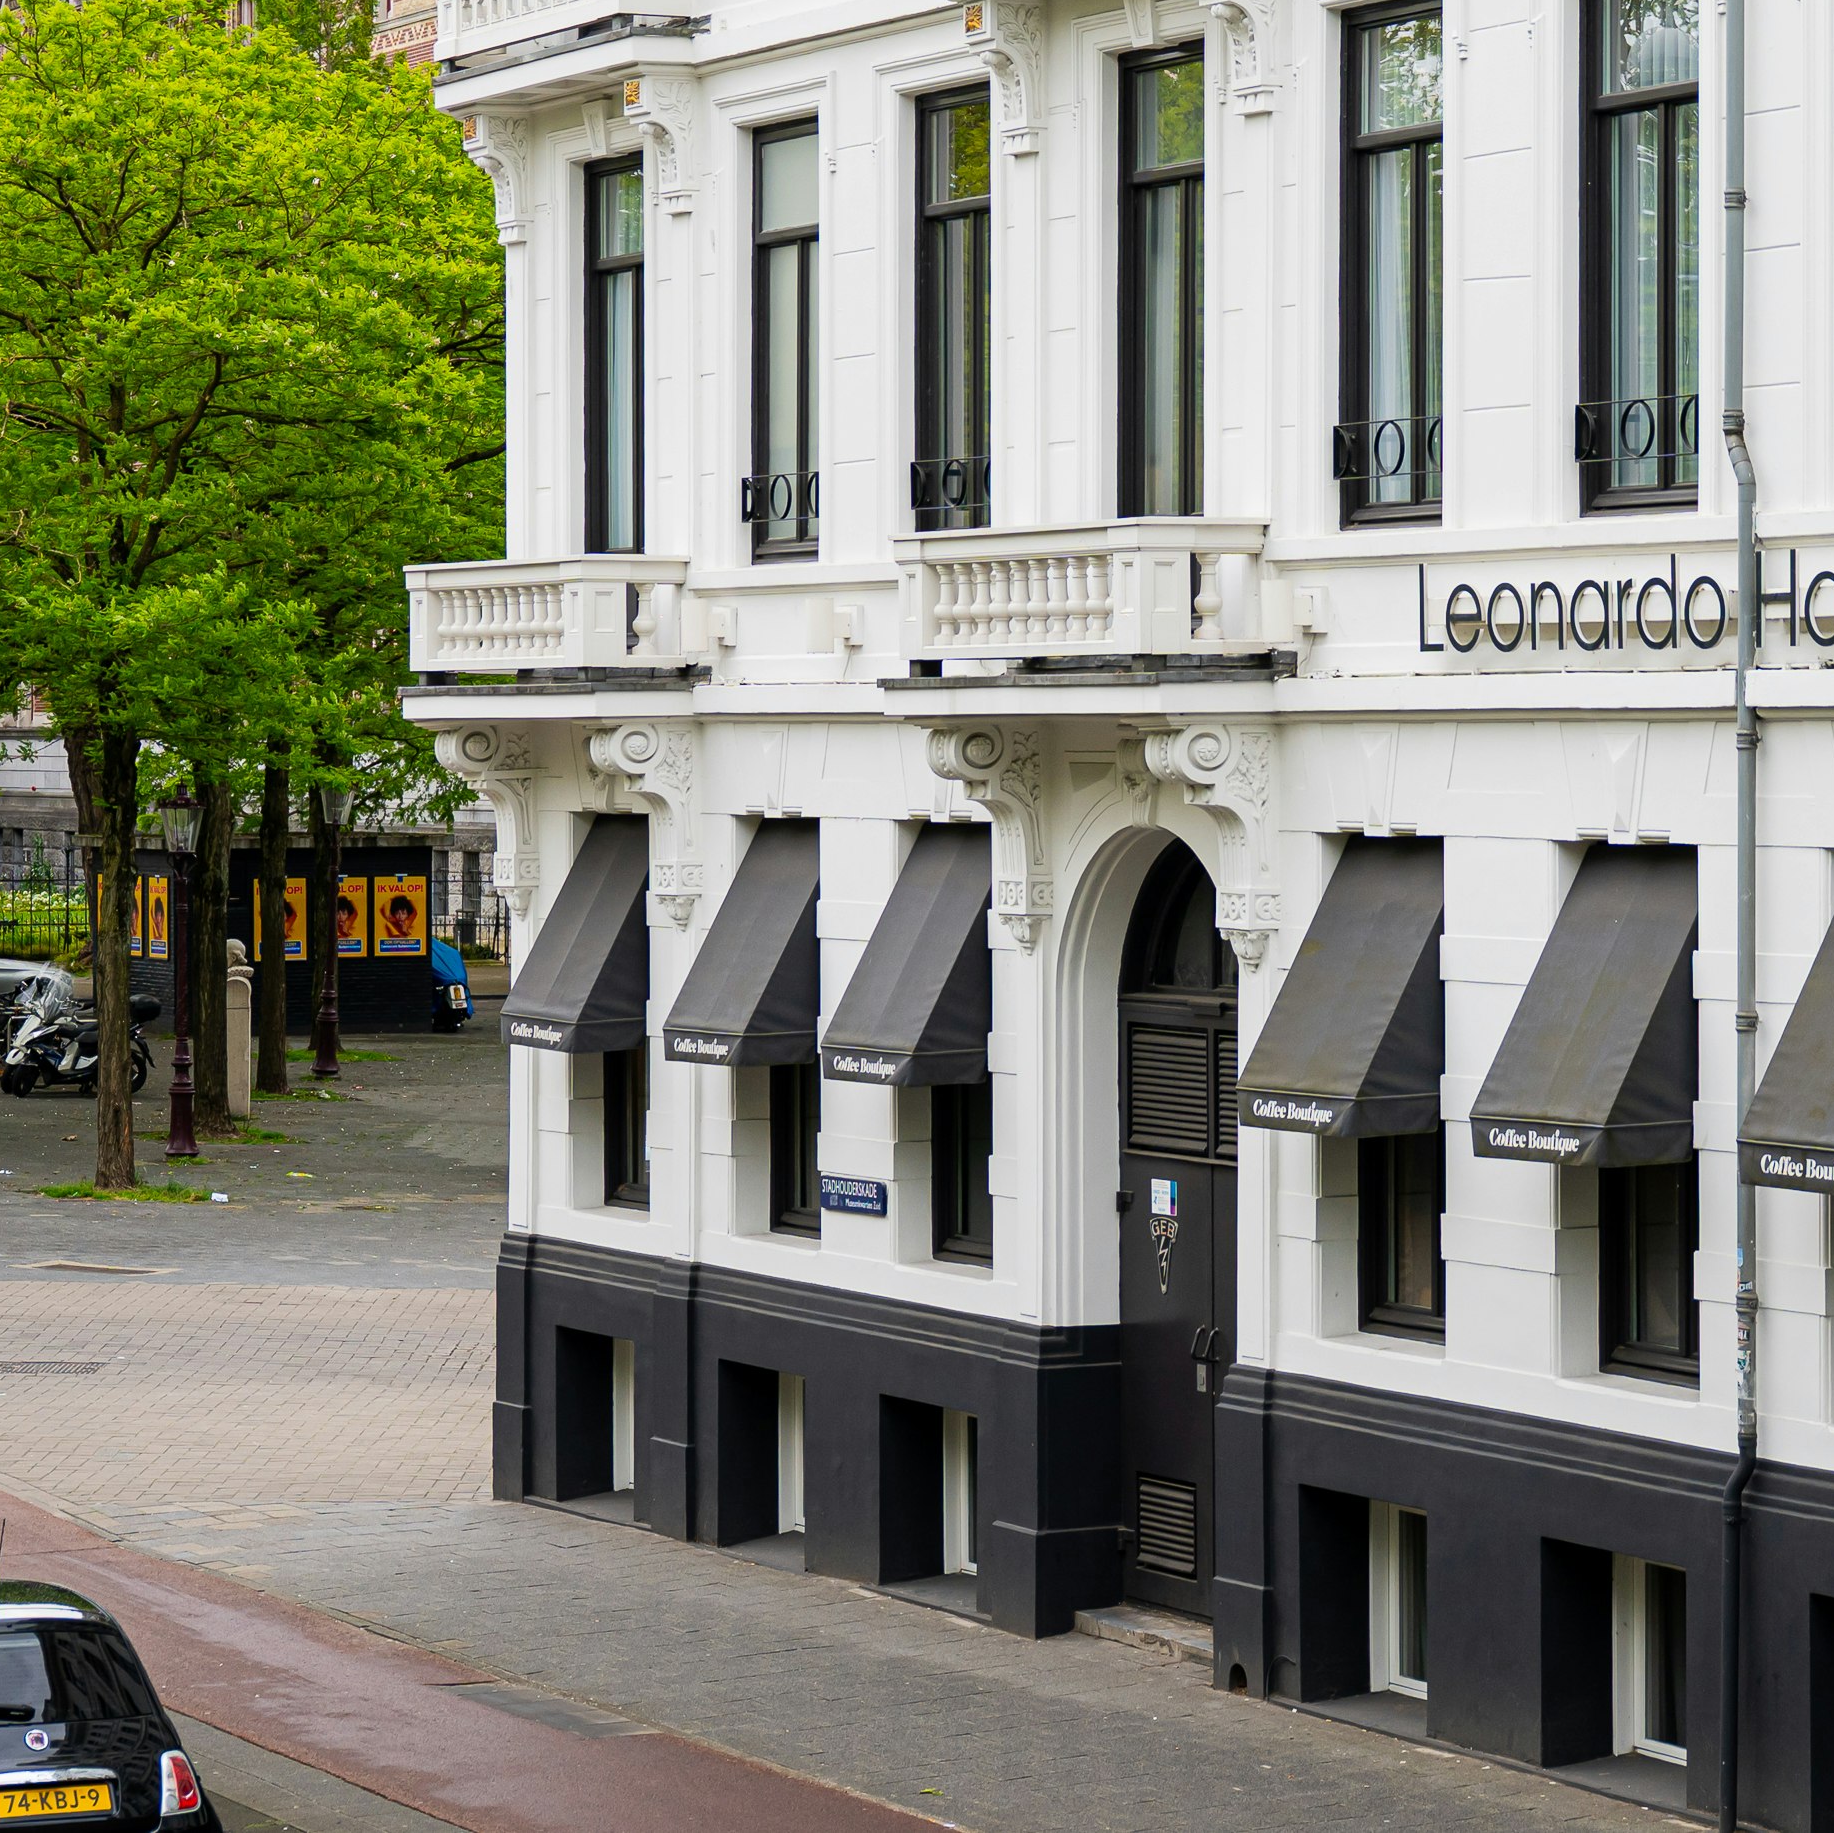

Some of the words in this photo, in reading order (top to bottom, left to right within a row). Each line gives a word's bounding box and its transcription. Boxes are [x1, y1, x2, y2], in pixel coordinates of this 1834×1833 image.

[1419, 553, 1728, 653] Leonardo
[286, 886, 303, 895] OP!
[349, 884, 364, 894] OP!
[377, 885, 387, 893] IK
[388, 884, 406, 893] VAL
[407, 884, 424, 893] OP!
[510, 1021, 533, 1038] Coffee
[533, 1024, 563, 1043] Boutique
[673, 1037, 697, 1054] Coffee
[697, 1037, 729, 1058] Boutique
[832, 1055, 859, 1073] Coffee
[860, 1056, 897, 1078] Boutique
[1253, 1098, 1286, 1119] Coffee
[1287, 1101, 1333, 1125] Boutique
[1488, 1127, 1526, 1149] Coffee
[1528, 1129, 1580, 1156] Boutique
[1760, 1153, 1803, 1178] Coffee
[821, 1178, 878, 1199] STADHOUDERSKADE
[1151, 1219, 1175, 1238] GEB
[3, 1788, 100, 1814] 74-KBJ-9
